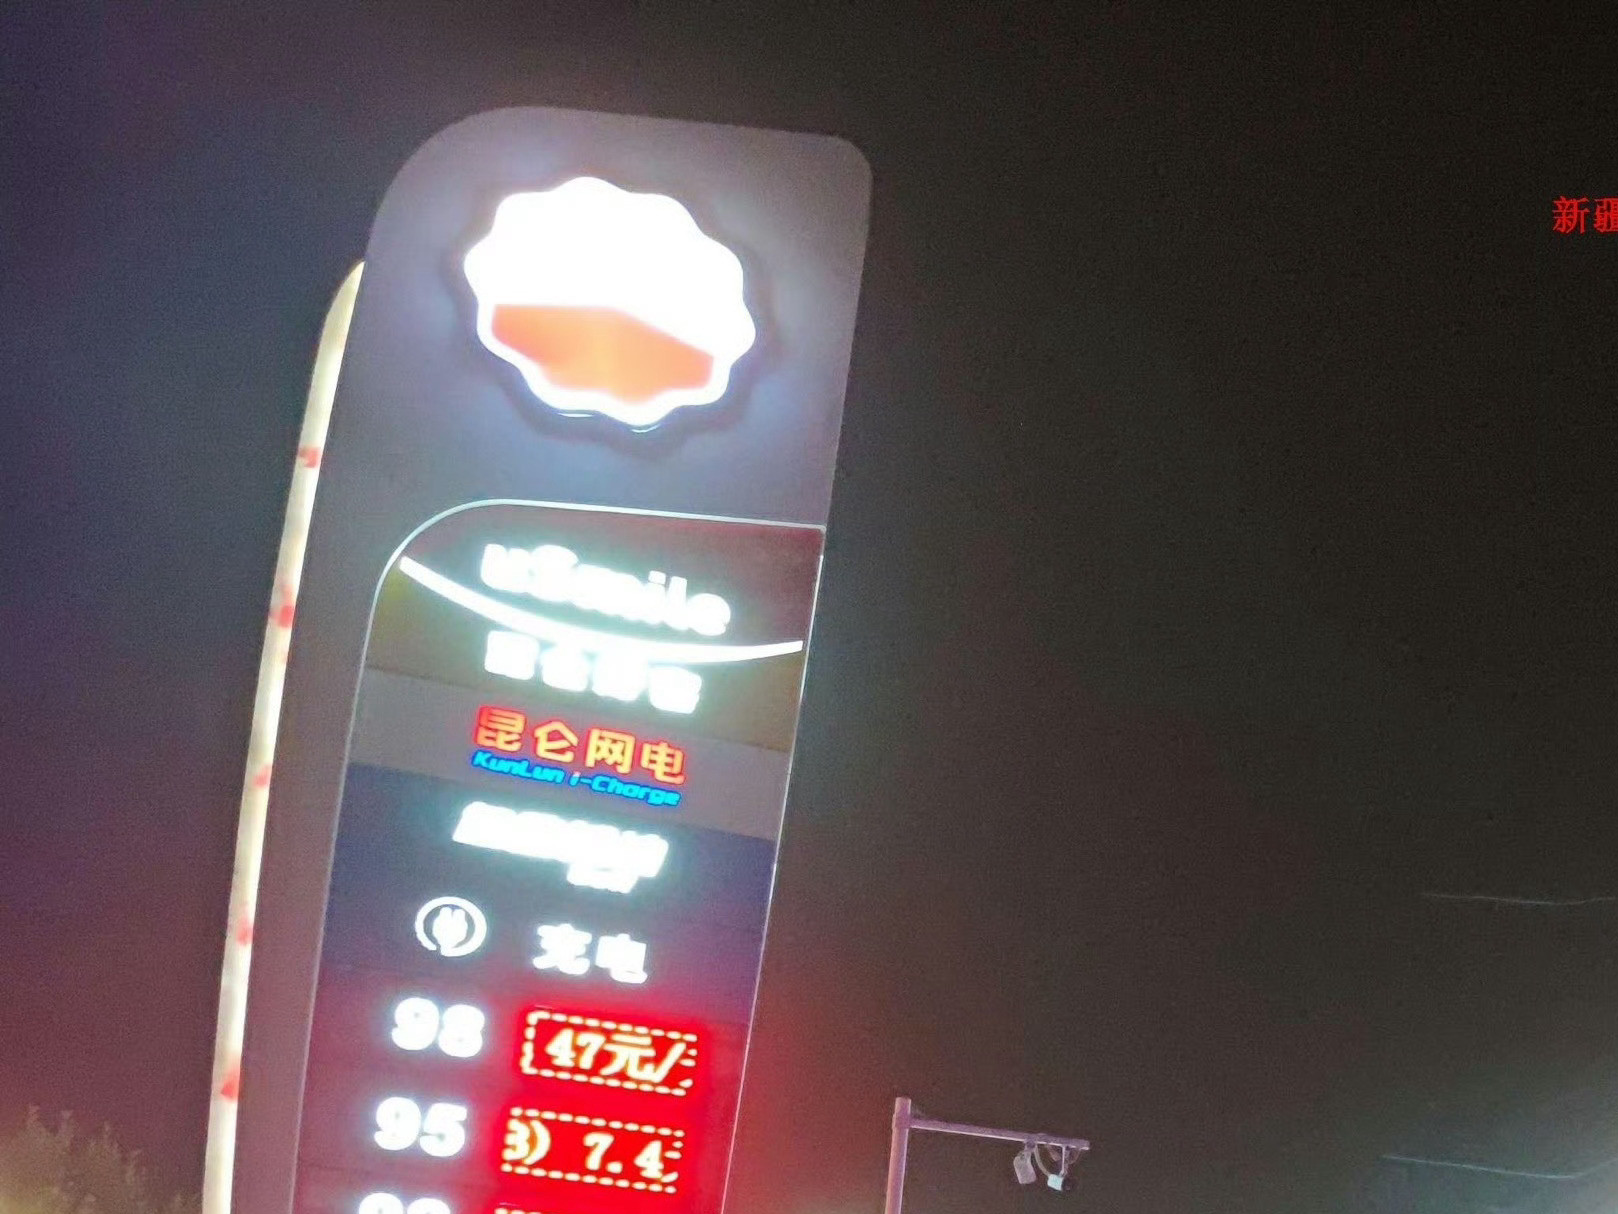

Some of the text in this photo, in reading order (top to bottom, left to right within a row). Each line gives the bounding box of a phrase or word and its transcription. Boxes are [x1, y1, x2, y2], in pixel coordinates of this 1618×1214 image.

[475, 706, 685, 785] 昆仑网电
[472, 750, 682, 806] KunLun i-Charge
[532, 923, 648, 982] 充电
[391, 997, 485, 1057] 98
[373, 1096, 468, 1157] 95
